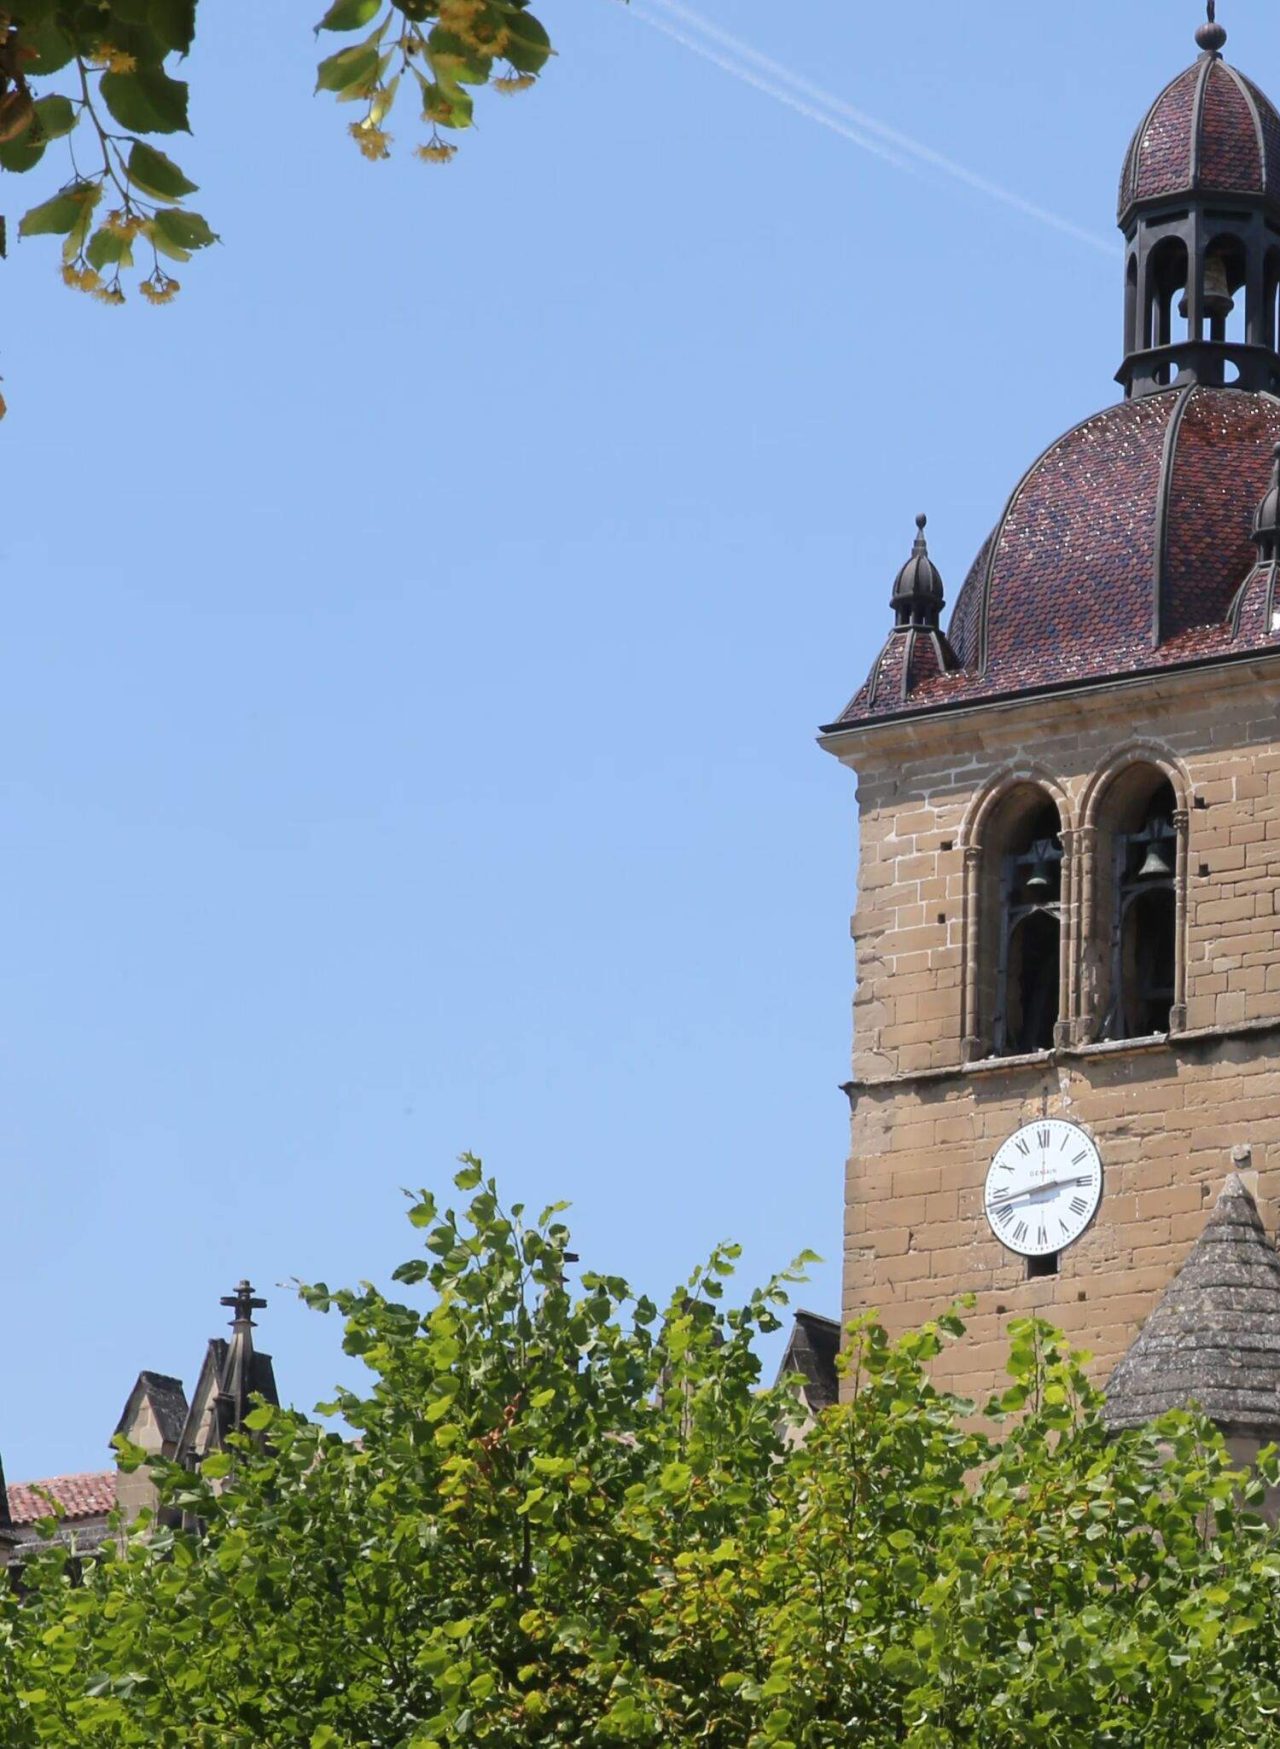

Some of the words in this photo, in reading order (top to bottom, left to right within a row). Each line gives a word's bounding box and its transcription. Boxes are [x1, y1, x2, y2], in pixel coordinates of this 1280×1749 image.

[1037, 1129, 1050, 1149] XII
[1015, 1138, 1030, 1158] XI
[1071, 1150, 1088, 1165] II
[999, 1163, 1015, 1174] X
[1076, 1175, 1092, 1187] III
[993, 1187, 1010, 1199] IX
[1012, 1220, 1029, 1243] VII
[1037, 1226, 1048, 1245] VI
